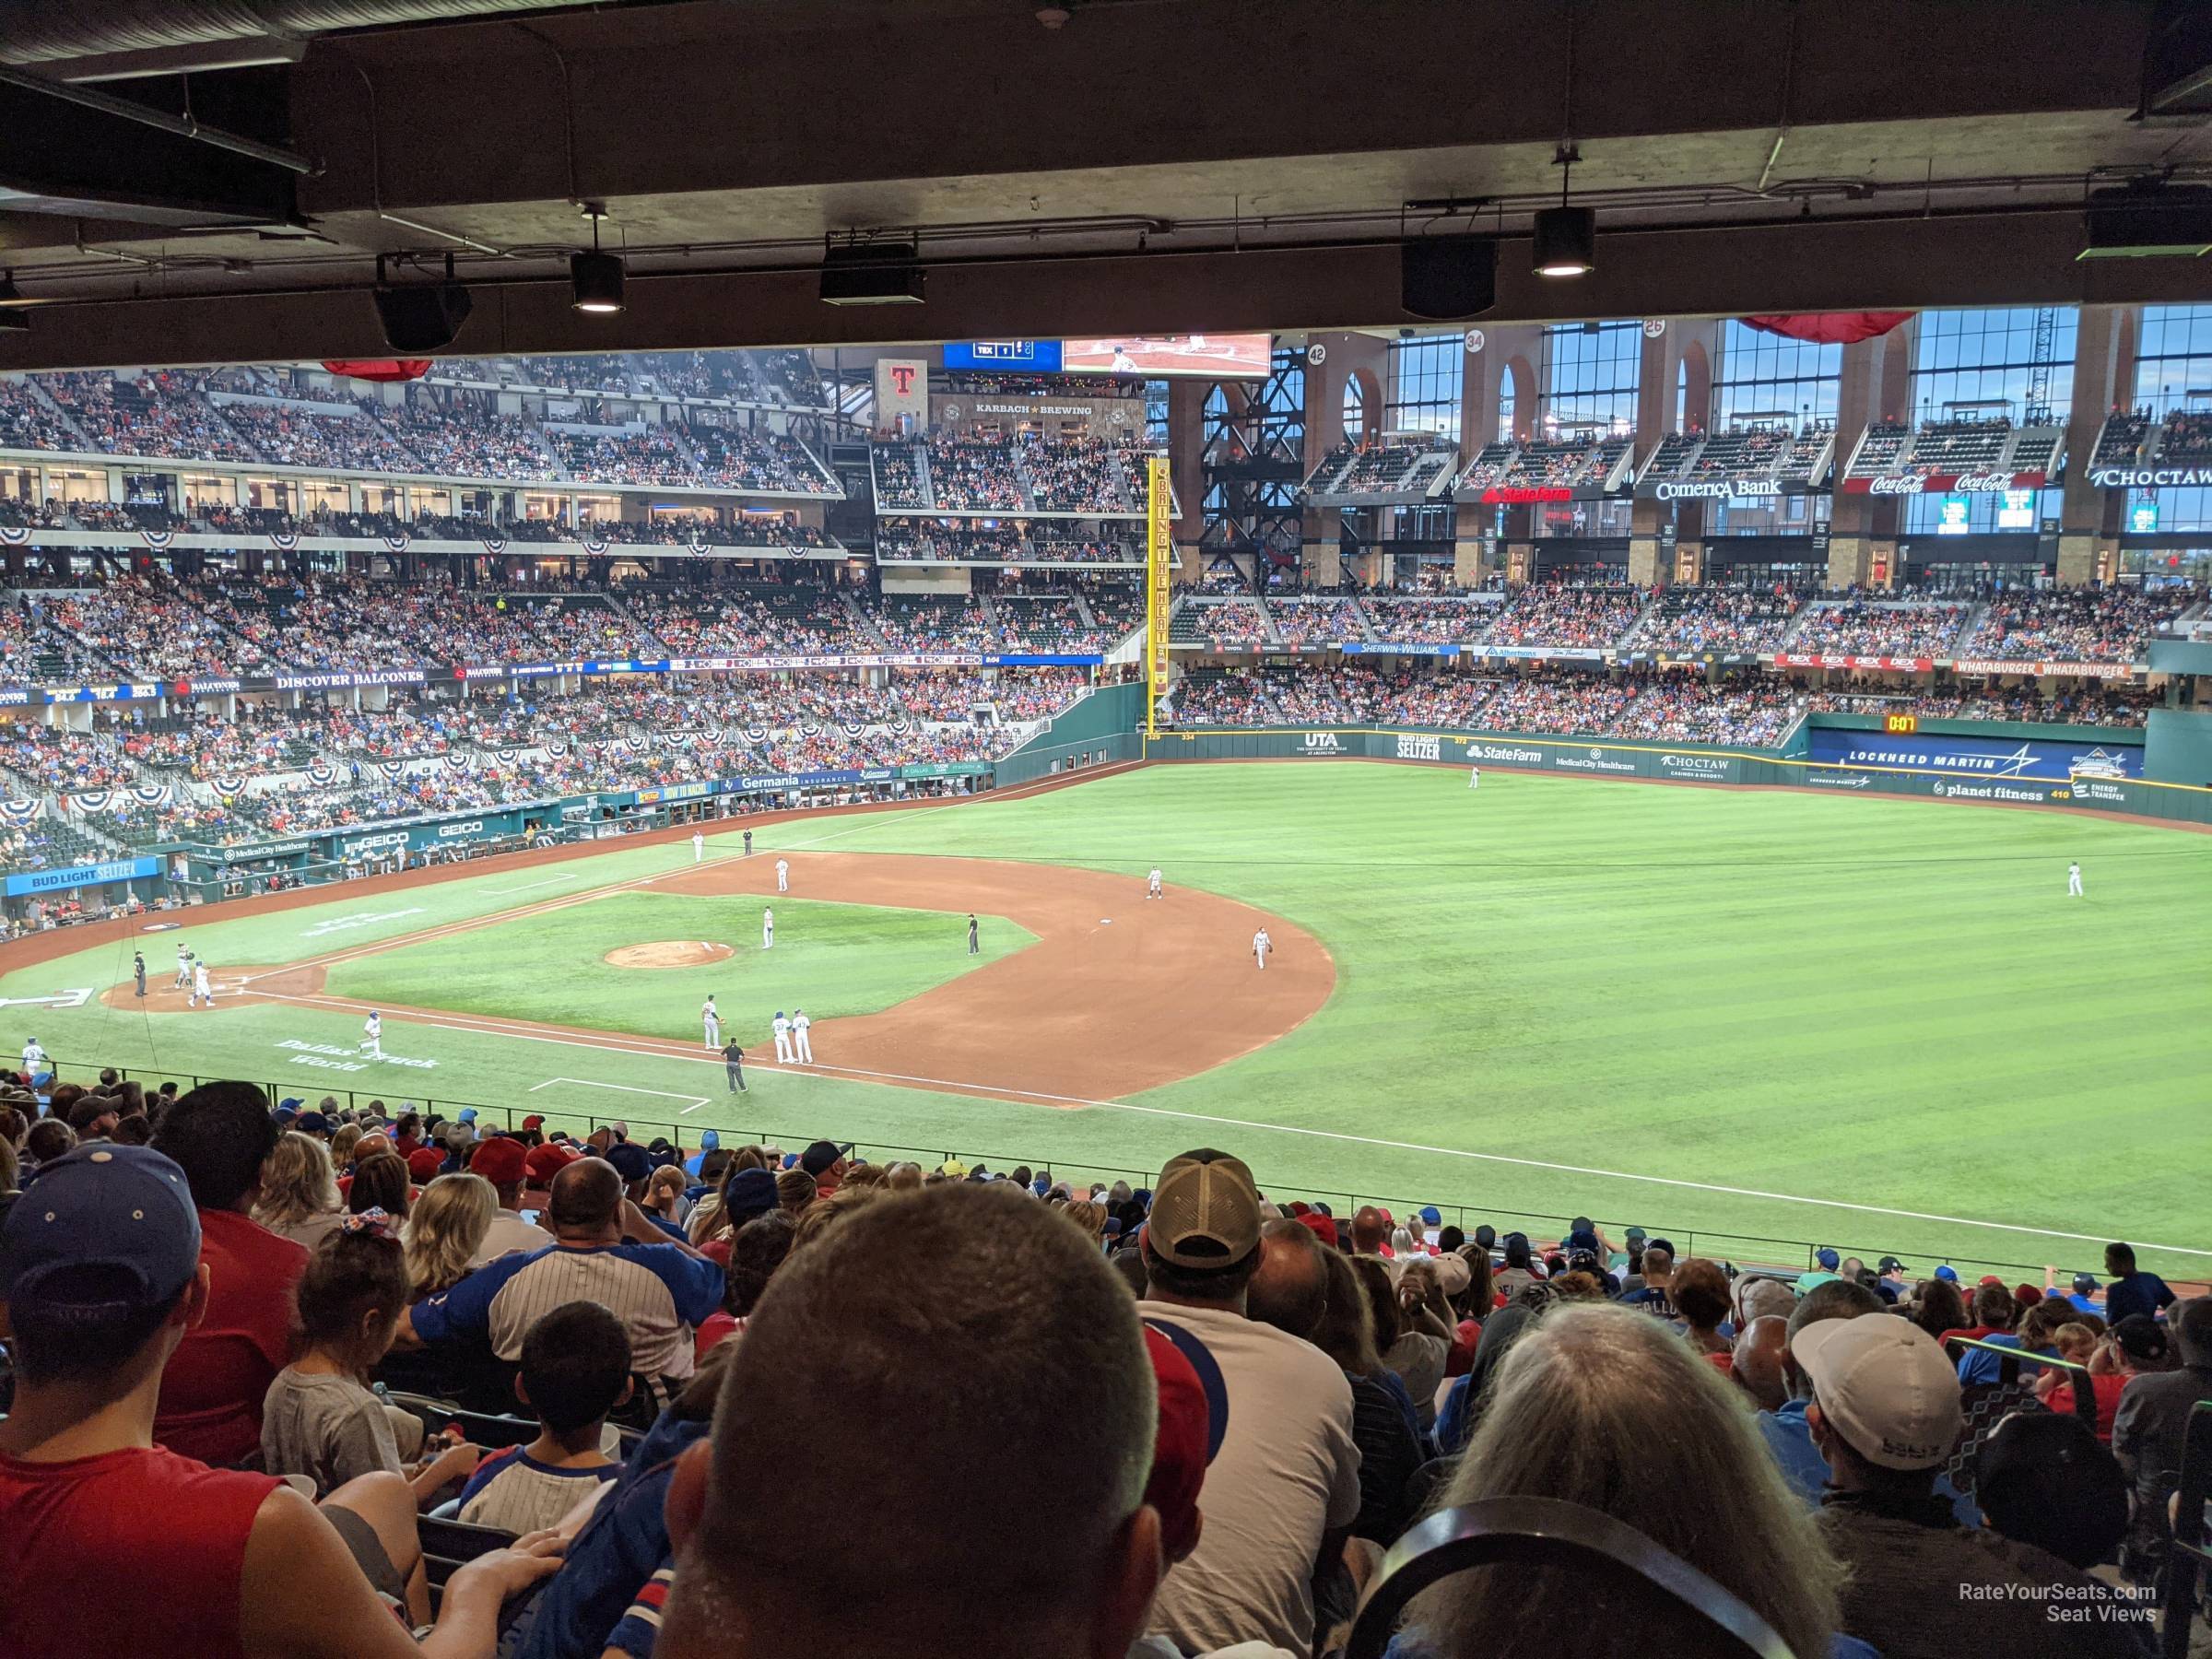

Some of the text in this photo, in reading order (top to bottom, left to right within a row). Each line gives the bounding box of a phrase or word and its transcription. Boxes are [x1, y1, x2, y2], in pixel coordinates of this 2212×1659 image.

[1645, 320, 1663, 333] 26
[1468, 335, 1482, 348] 34
[978, 347, 993, 355] TEX
[1310, 348, 1324, 361] 42
[891, 367, 915, 395] T
[976, 404, 1092, 415] KARBACH BREWING
[2102, 468, 2212, 485] CHOCTAW
[1736, 478, 1782, 497] Bank
[1158, 479, 1168, 546] BRING
[1158, 548, 1168, 589] THE
[1158, 592, 1168, 642] HEAT
[1361, 643, 1440, 654] SHERWIN-WILLIAMS
[1499, 648, 1536, 657] Albertsons
[1787, 654, 1812, 664] DEX
[1820, 655, 1845, 664] DEX
[1855, 656, 1880, 665] DEX
[1890, 657, 1916, 666] DEX
[1957, 661, 2035, 674] WHATABURGER
[2042, 664, 2124, 676] WHATABURGER
[277, 670, 424, 689] DISCOVER BALCONES
[1889, 716, 1914, 731] 0:07
[1305, 733, 1338, 747] UTA
[1417, 735, 1440, 744] LIGHT
[1397, 743, 1440, 760] SELTZER
[1556, 758, 1635, 771] Medical City Healthcare
[1666, 756, 1729, 770] CHOCTAW
[1850, 751, 1995, 769] LOCKHEED MARTIN
[742, 775, 799, 789] Germania
[2091, 784, 2119, 793] ENERGY
[665, 788, 679, 798] HOW
[679, 786, 688, 796] TO
[1947, 784, 2043, 801] planet fitness
[2051, 790, 2069, 799] 410
[2091, 791, 2125, 801] TRANSFER
[439, 821, 483, 838] GEICO
[361, 831, 409, 849] GEICO
[235, 847, 262, 858] Medical
[261, 846, 276, 857] City
[276, 841, 310, 853] Healthcare
[32, 874, 59, 888] BUD
[60, 870, 97, 885] LIGHT
[273, 1039, 358, 1056] Dallas
